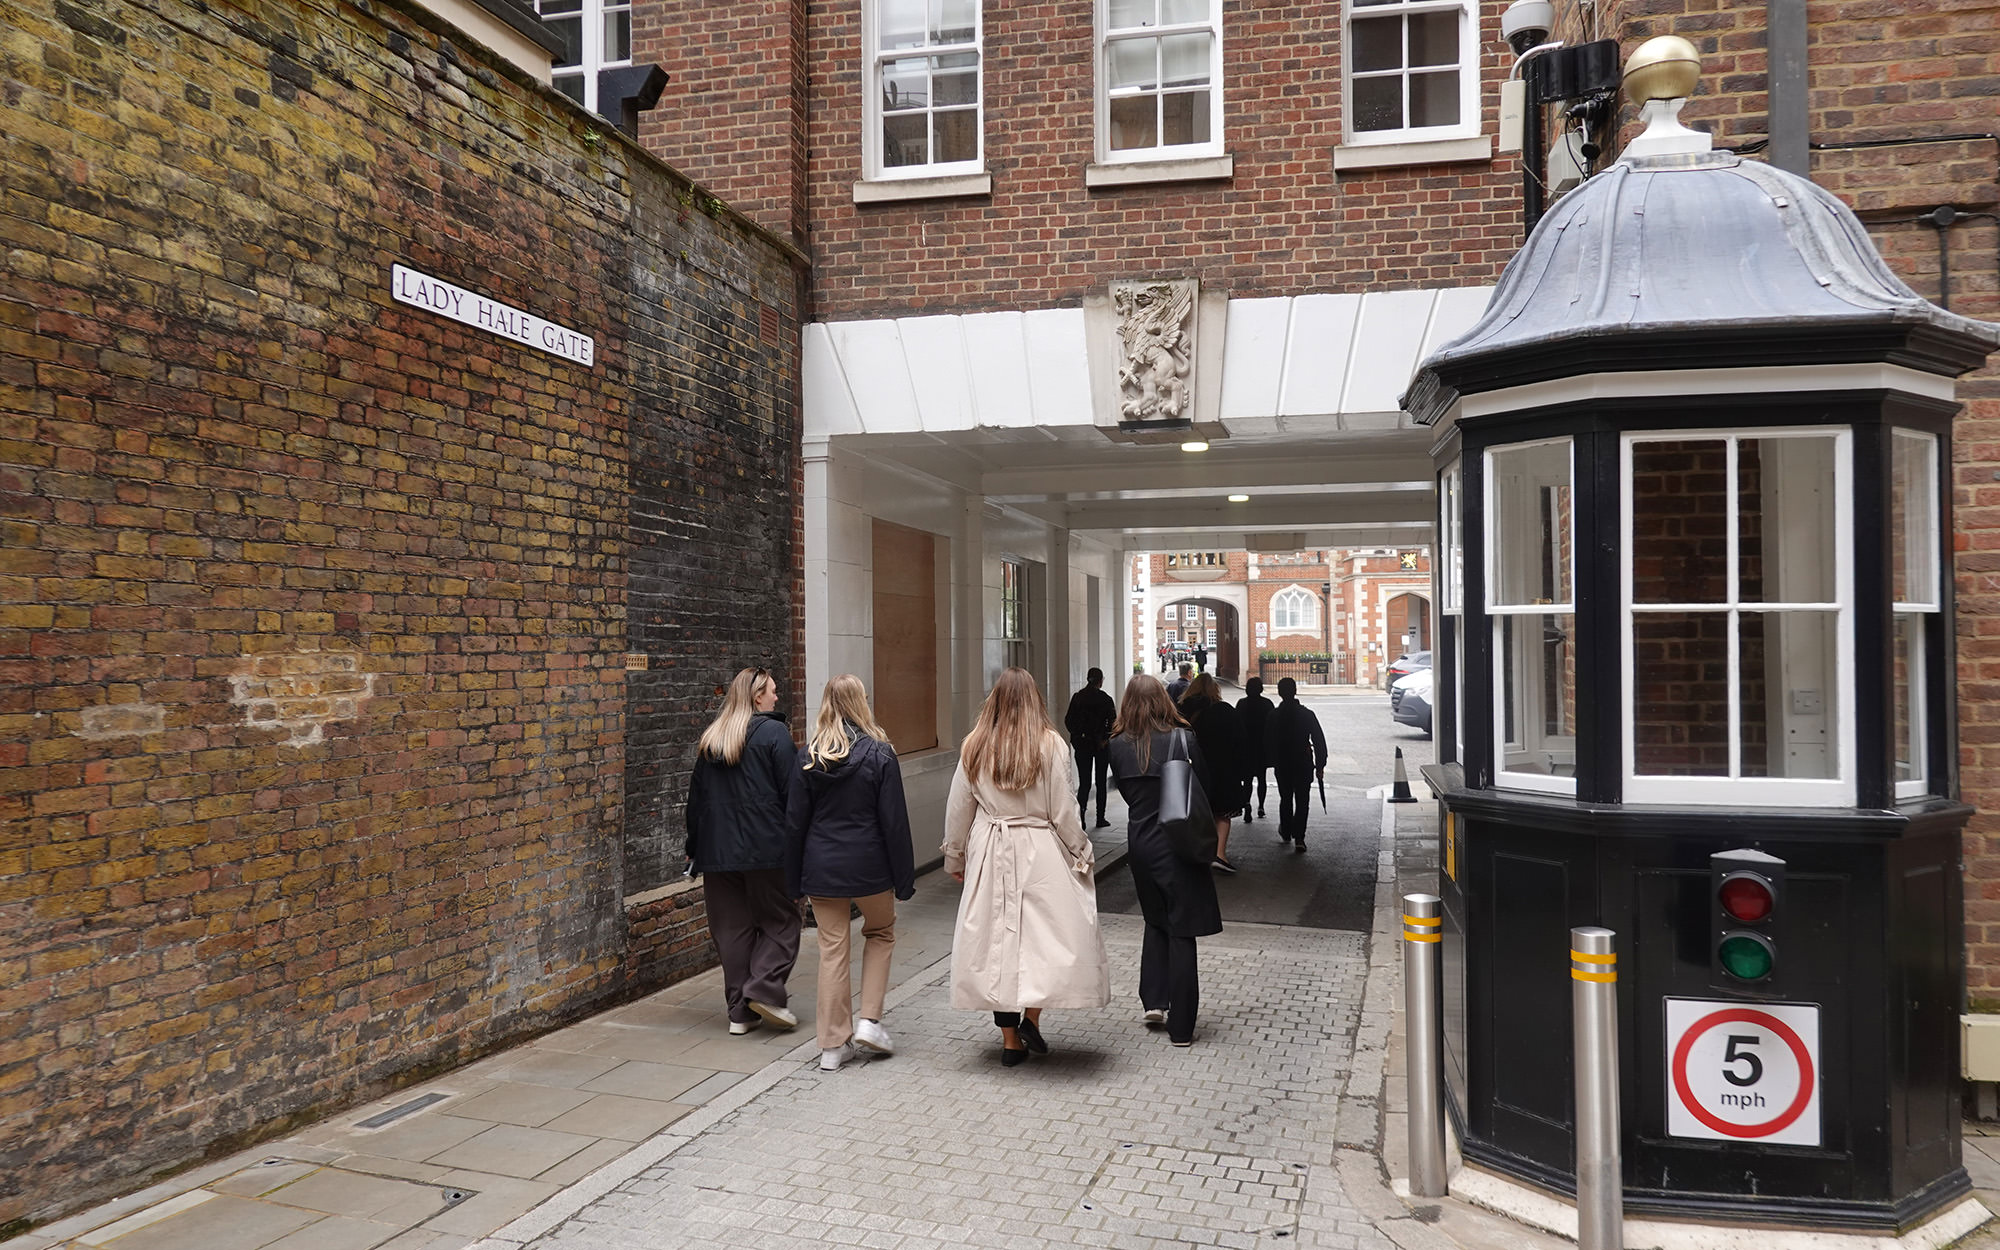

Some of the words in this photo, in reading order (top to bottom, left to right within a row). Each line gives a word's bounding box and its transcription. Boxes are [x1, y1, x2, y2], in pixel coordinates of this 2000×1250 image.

[401, 272, 464, 316] LADY
[478, 300, 530, 341] HALE
[542, 326, 589, 361] GATE
[1722, 1034, 1763, 1087] 5
[1720, 1092, 1766, 1110] mph
